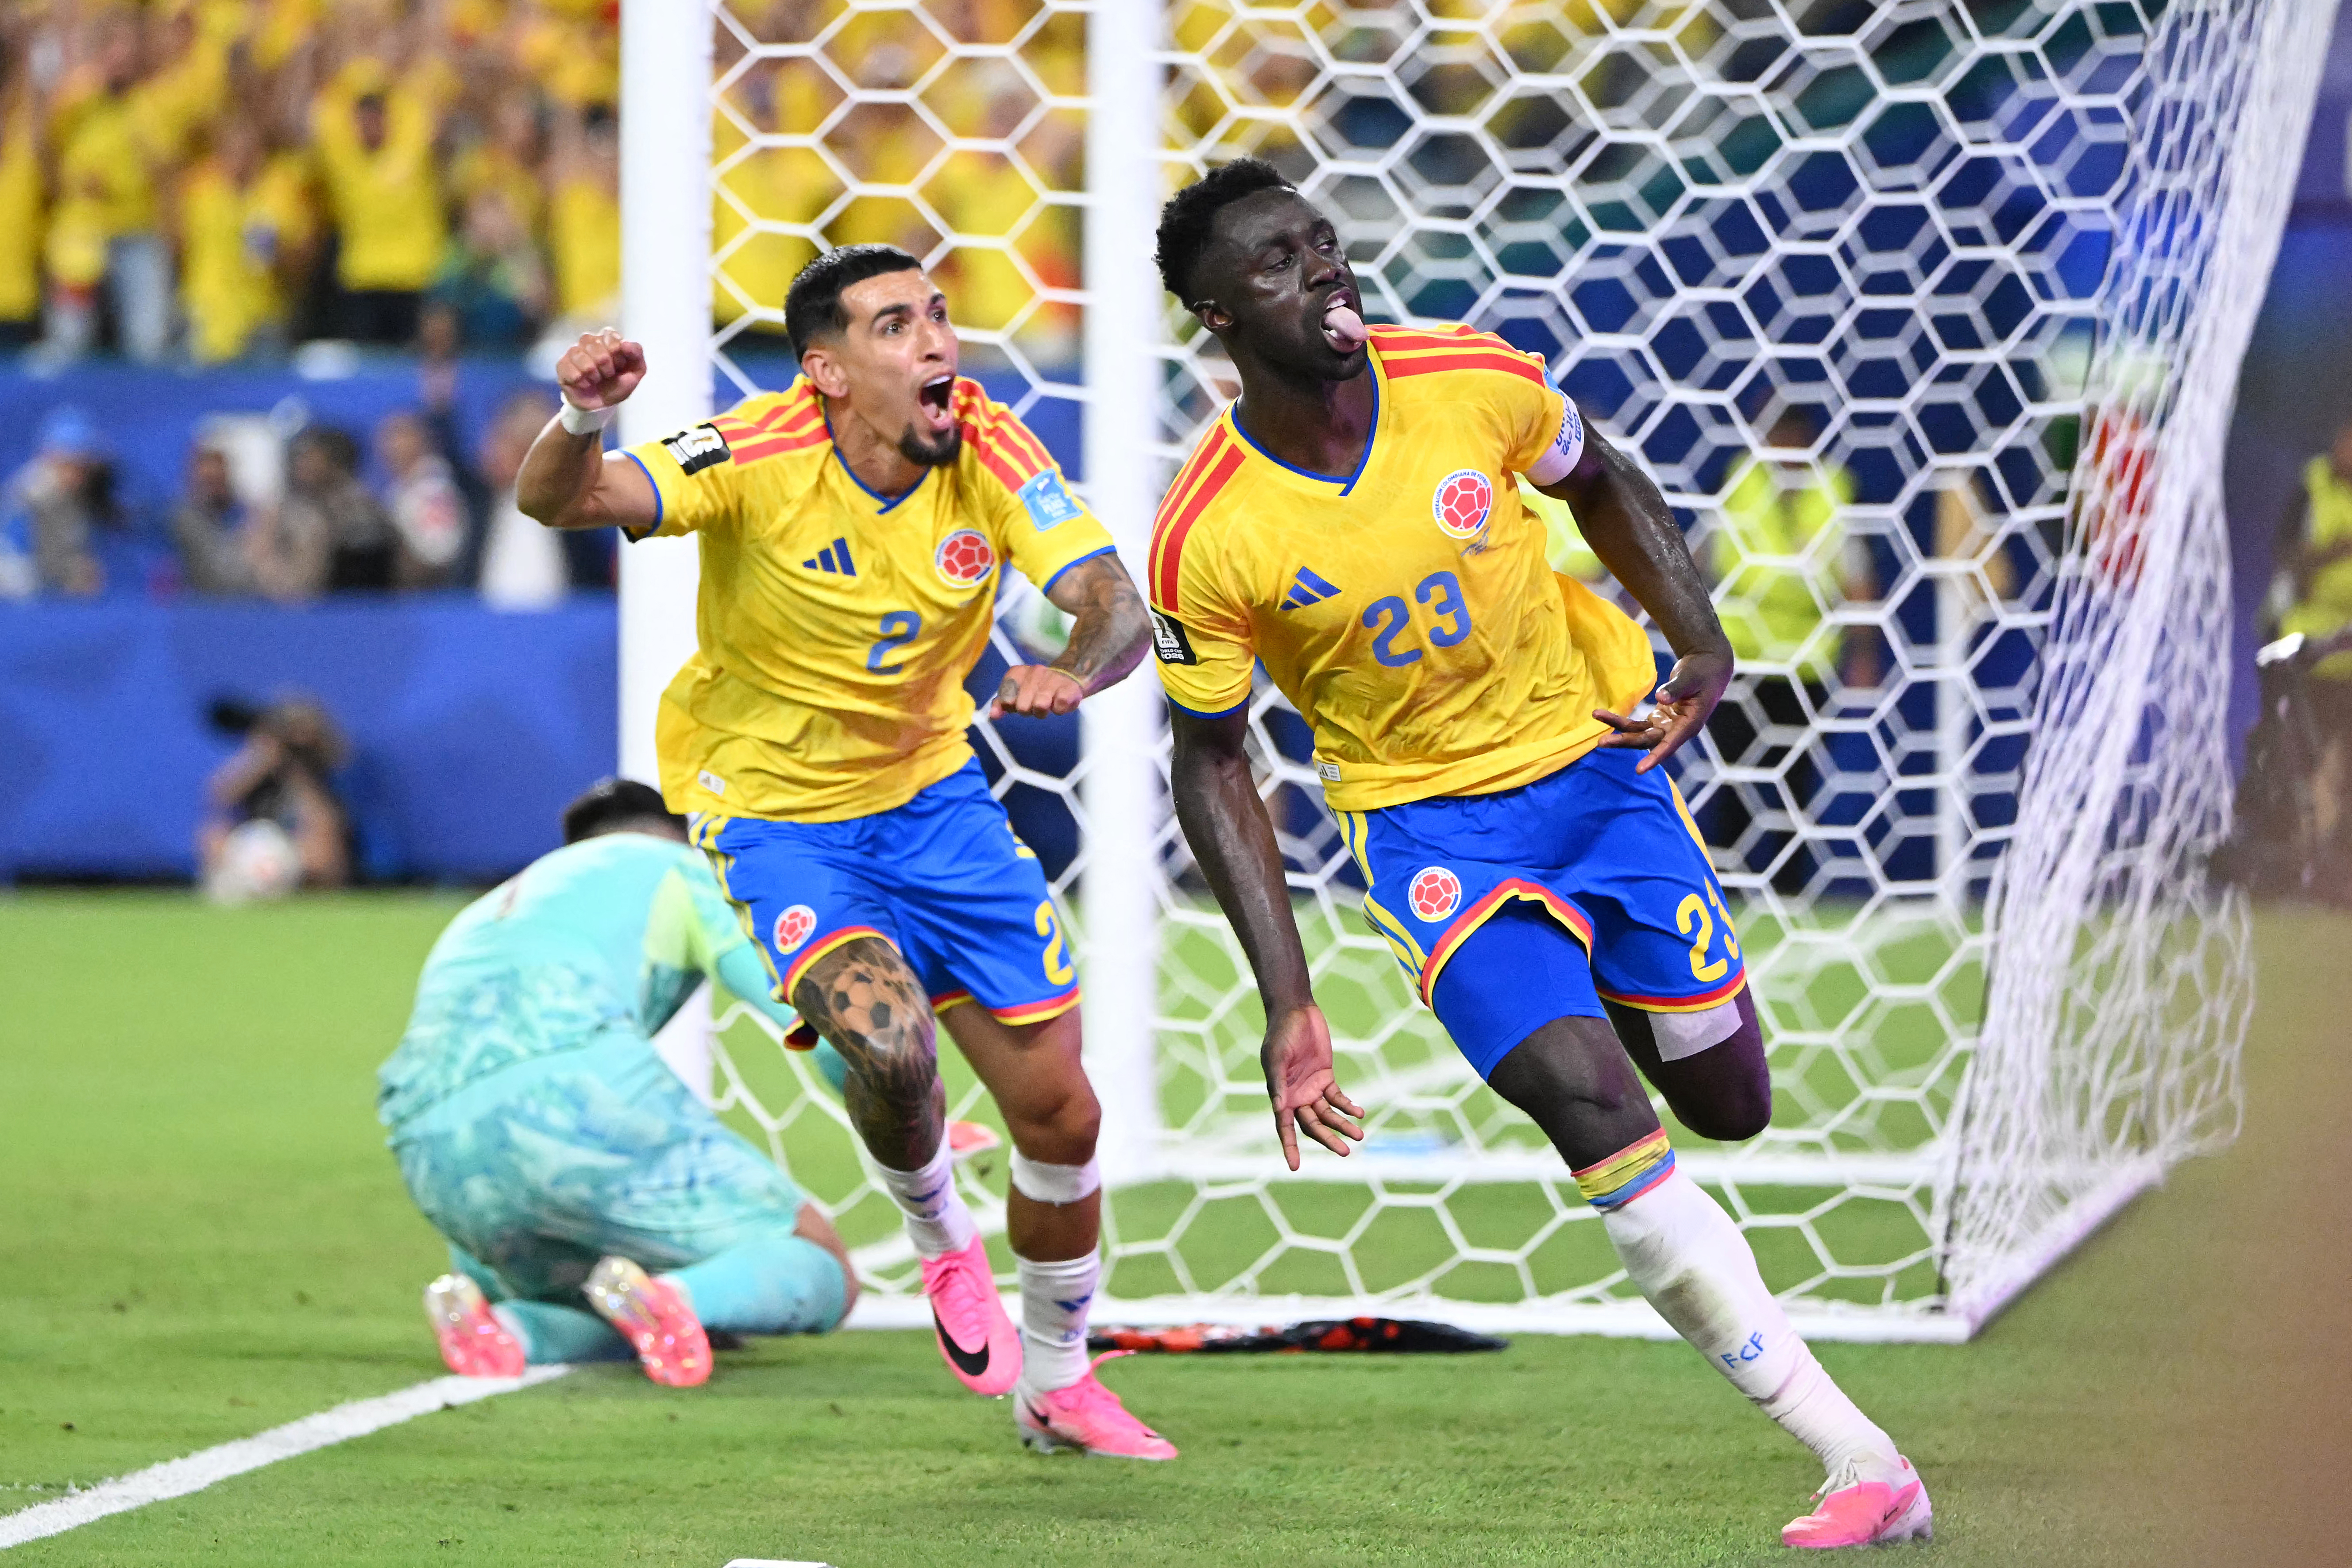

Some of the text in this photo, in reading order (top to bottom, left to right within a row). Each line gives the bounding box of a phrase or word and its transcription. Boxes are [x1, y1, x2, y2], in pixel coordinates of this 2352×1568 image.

[865, 610, 922, 675] 2
[1362, 571, 1472, 667] 23
[1035, 900, 1074, 986] 2
[1720, 1332, 1763, 1368] FCF
